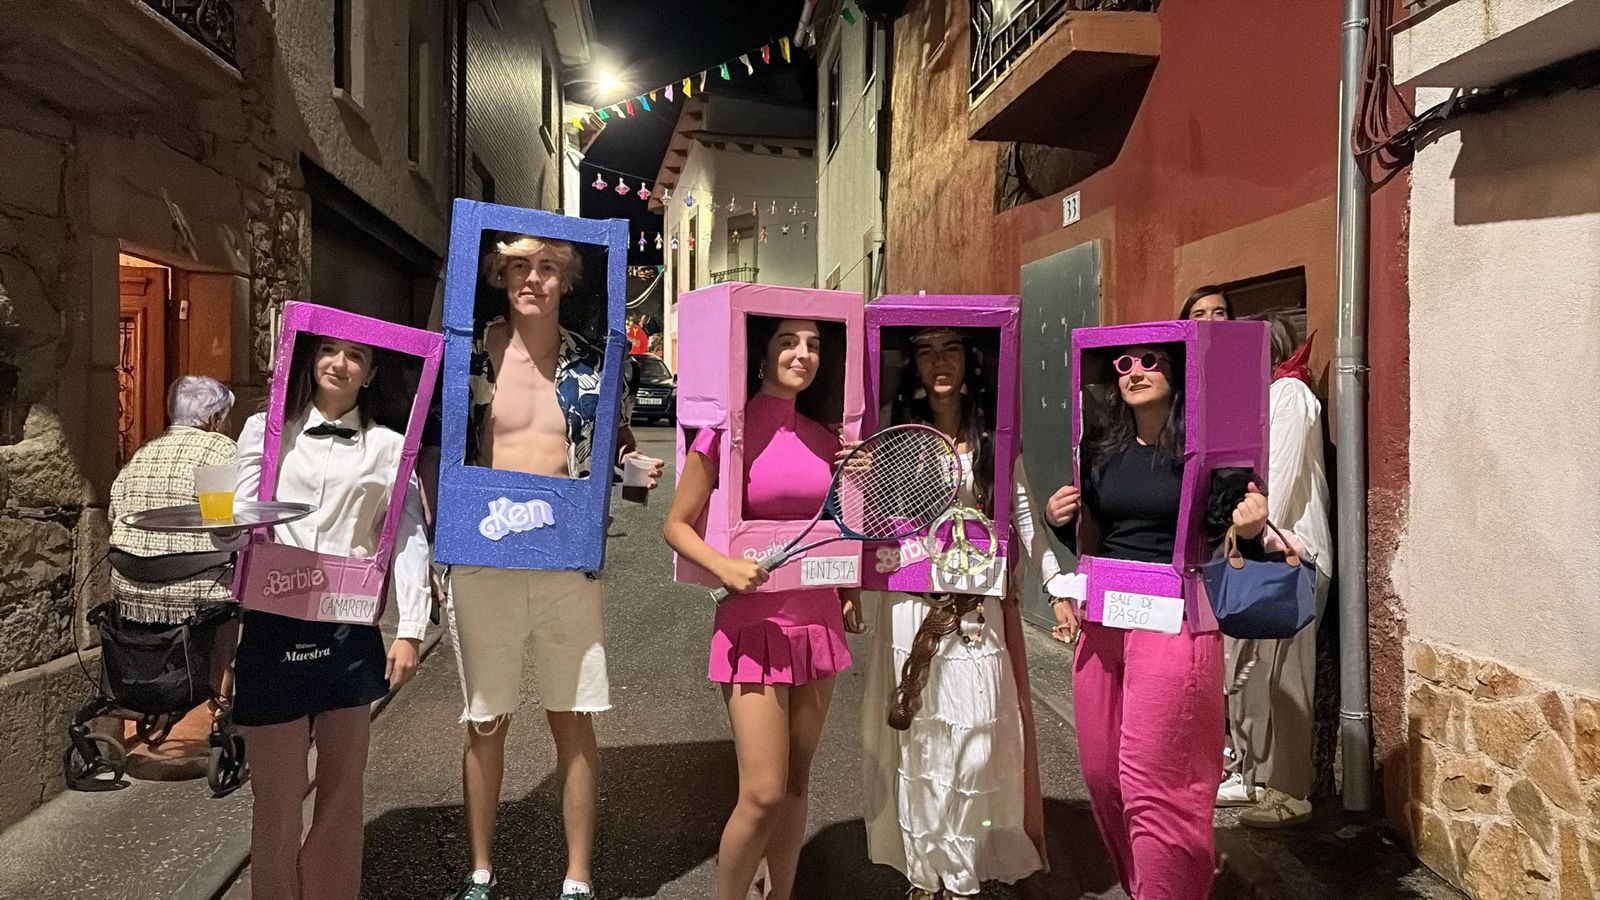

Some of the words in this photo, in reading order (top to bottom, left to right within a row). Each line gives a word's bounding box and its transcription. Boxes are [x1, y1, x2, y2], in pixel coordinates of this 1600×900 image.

[1066, 198, 1077, 221] 33
[481, 499, 549, 537] Ken
[802, 559, 857, 581] TENISTA
[263, 567, 324, 596] Barbie
[1110, 592, 1133, 606] SALE
[1141, 597, 1155, 610] DE
[1107, 604, 1150, 625] PASEO
[281, 648, 330, 662] Maestra
